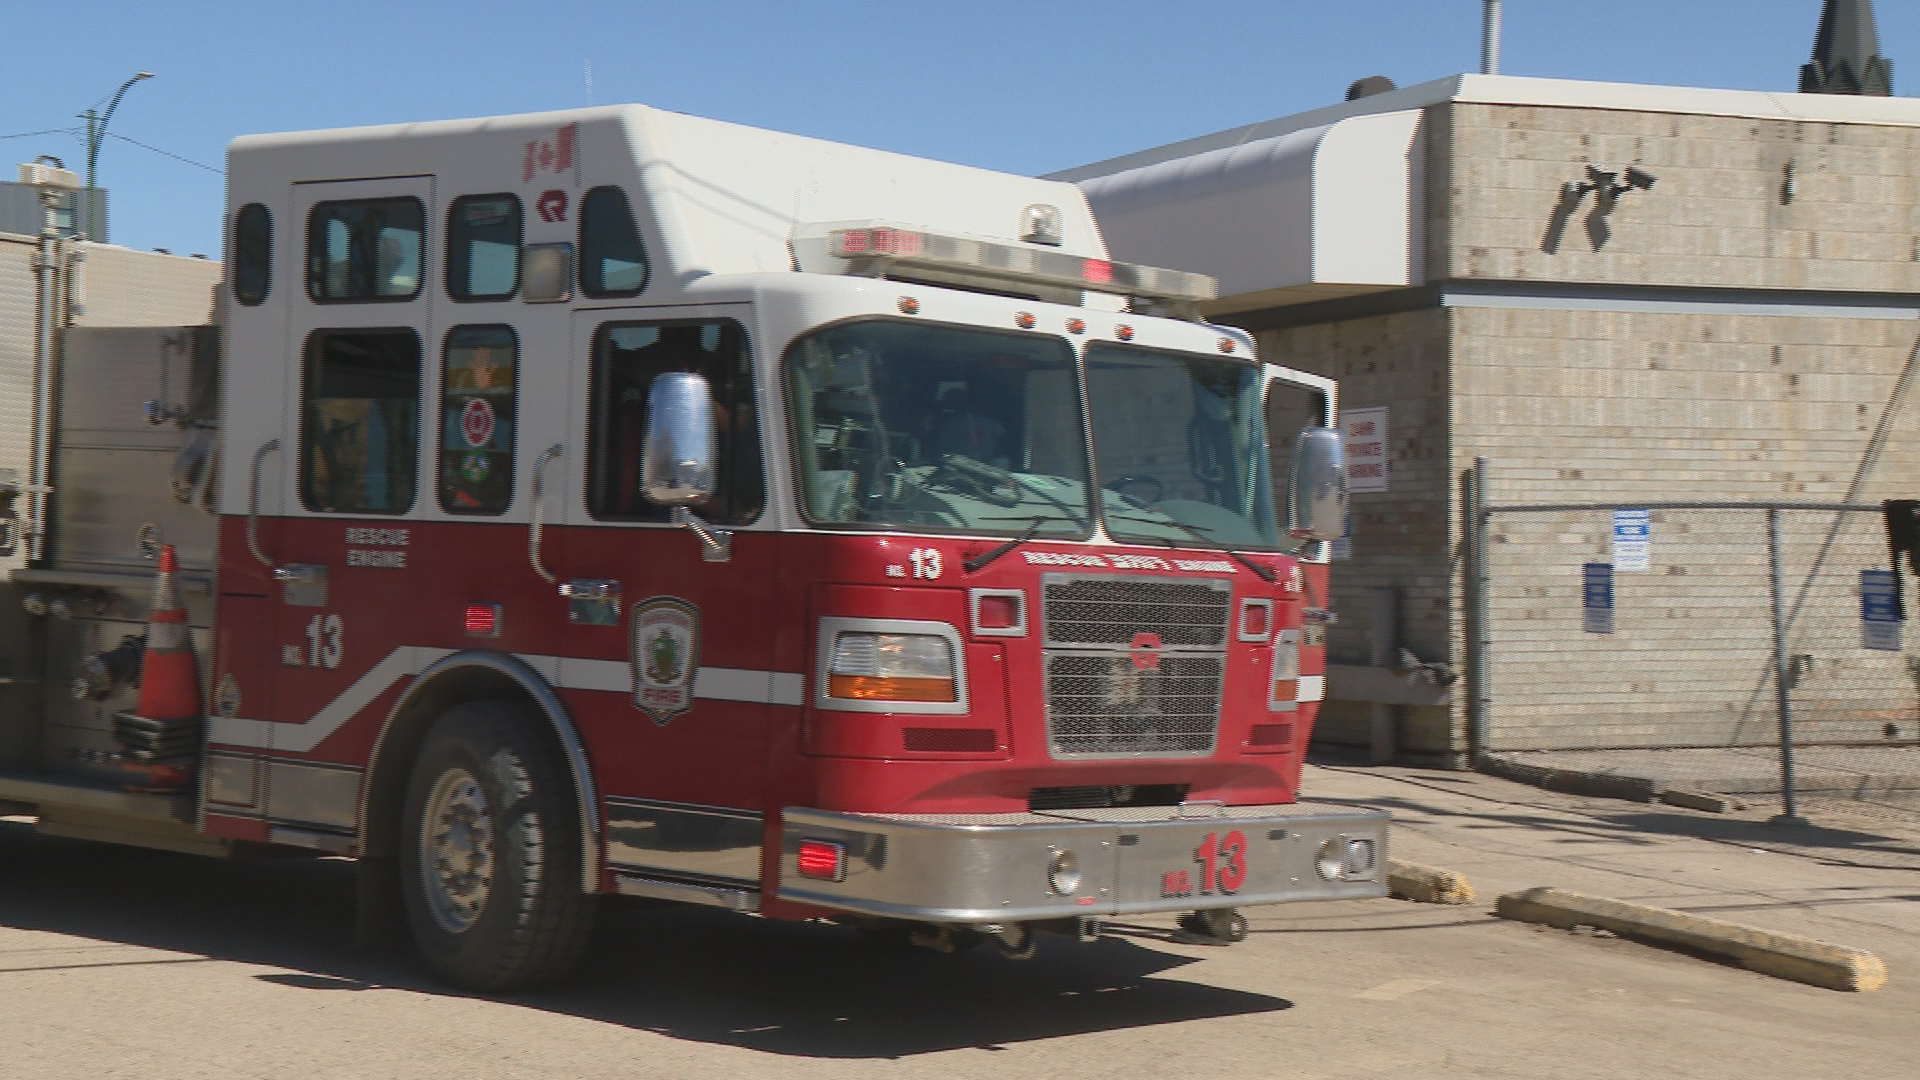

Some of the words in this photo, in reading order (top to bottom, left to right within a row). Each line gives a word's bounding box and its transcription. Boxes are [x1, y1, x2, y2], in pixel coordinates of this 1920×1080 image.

[1347, 463, 1383, 479] ARKING
[345, 527, 411, 546] RESCUE
[346, 549, 408, 568] ENGINE
[908, 548, 943, 580] 13
[1020, 551, 1108, 568] RESCUE
[1170, 559, 1238, 574] ENGINE
[281, 645, 305, 666] NO.
[305, 613, 344, 670] 13
[642, 687, 681, 705] FIRE
[1161, 869, 1193, 897] NO.
[1194, 829, 1248, 894] 13
